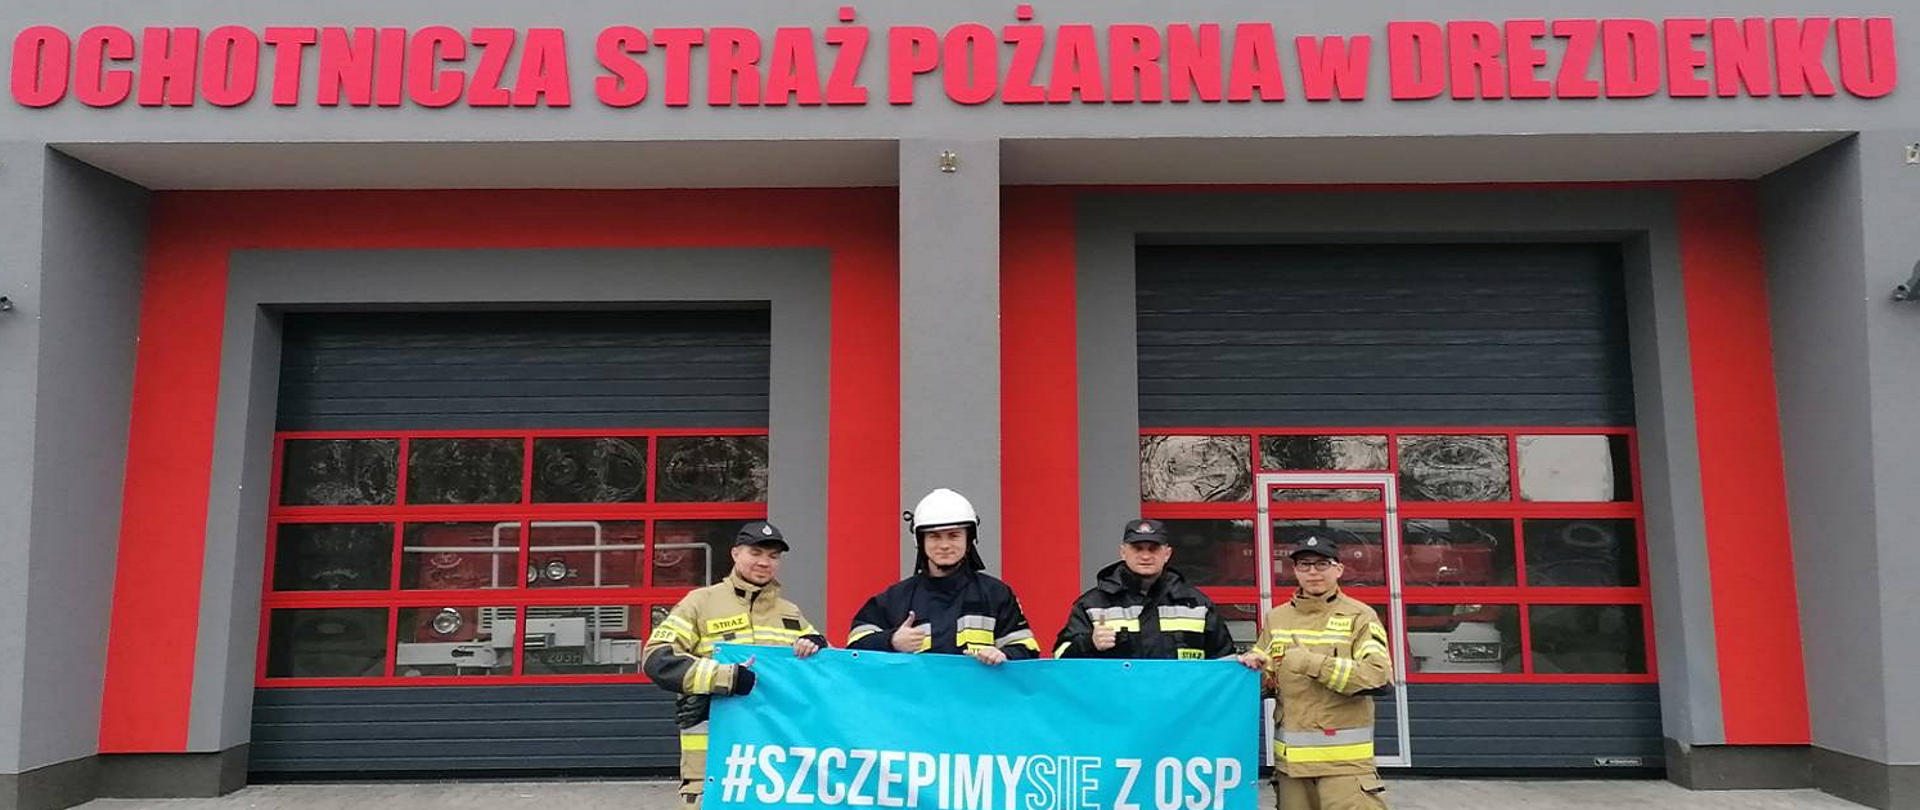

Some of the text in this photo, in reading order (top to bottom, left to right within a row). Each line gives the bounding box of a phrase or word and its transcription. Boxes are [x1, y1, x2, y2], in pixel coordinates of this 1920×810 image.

[10, 5, 1898, 107] OCHOTNICZA STRAŻ POŻARNA w DREZDENKU
[1114, 758, 1142, 810] Z
[1155, 757, 1242, 810] OSP
